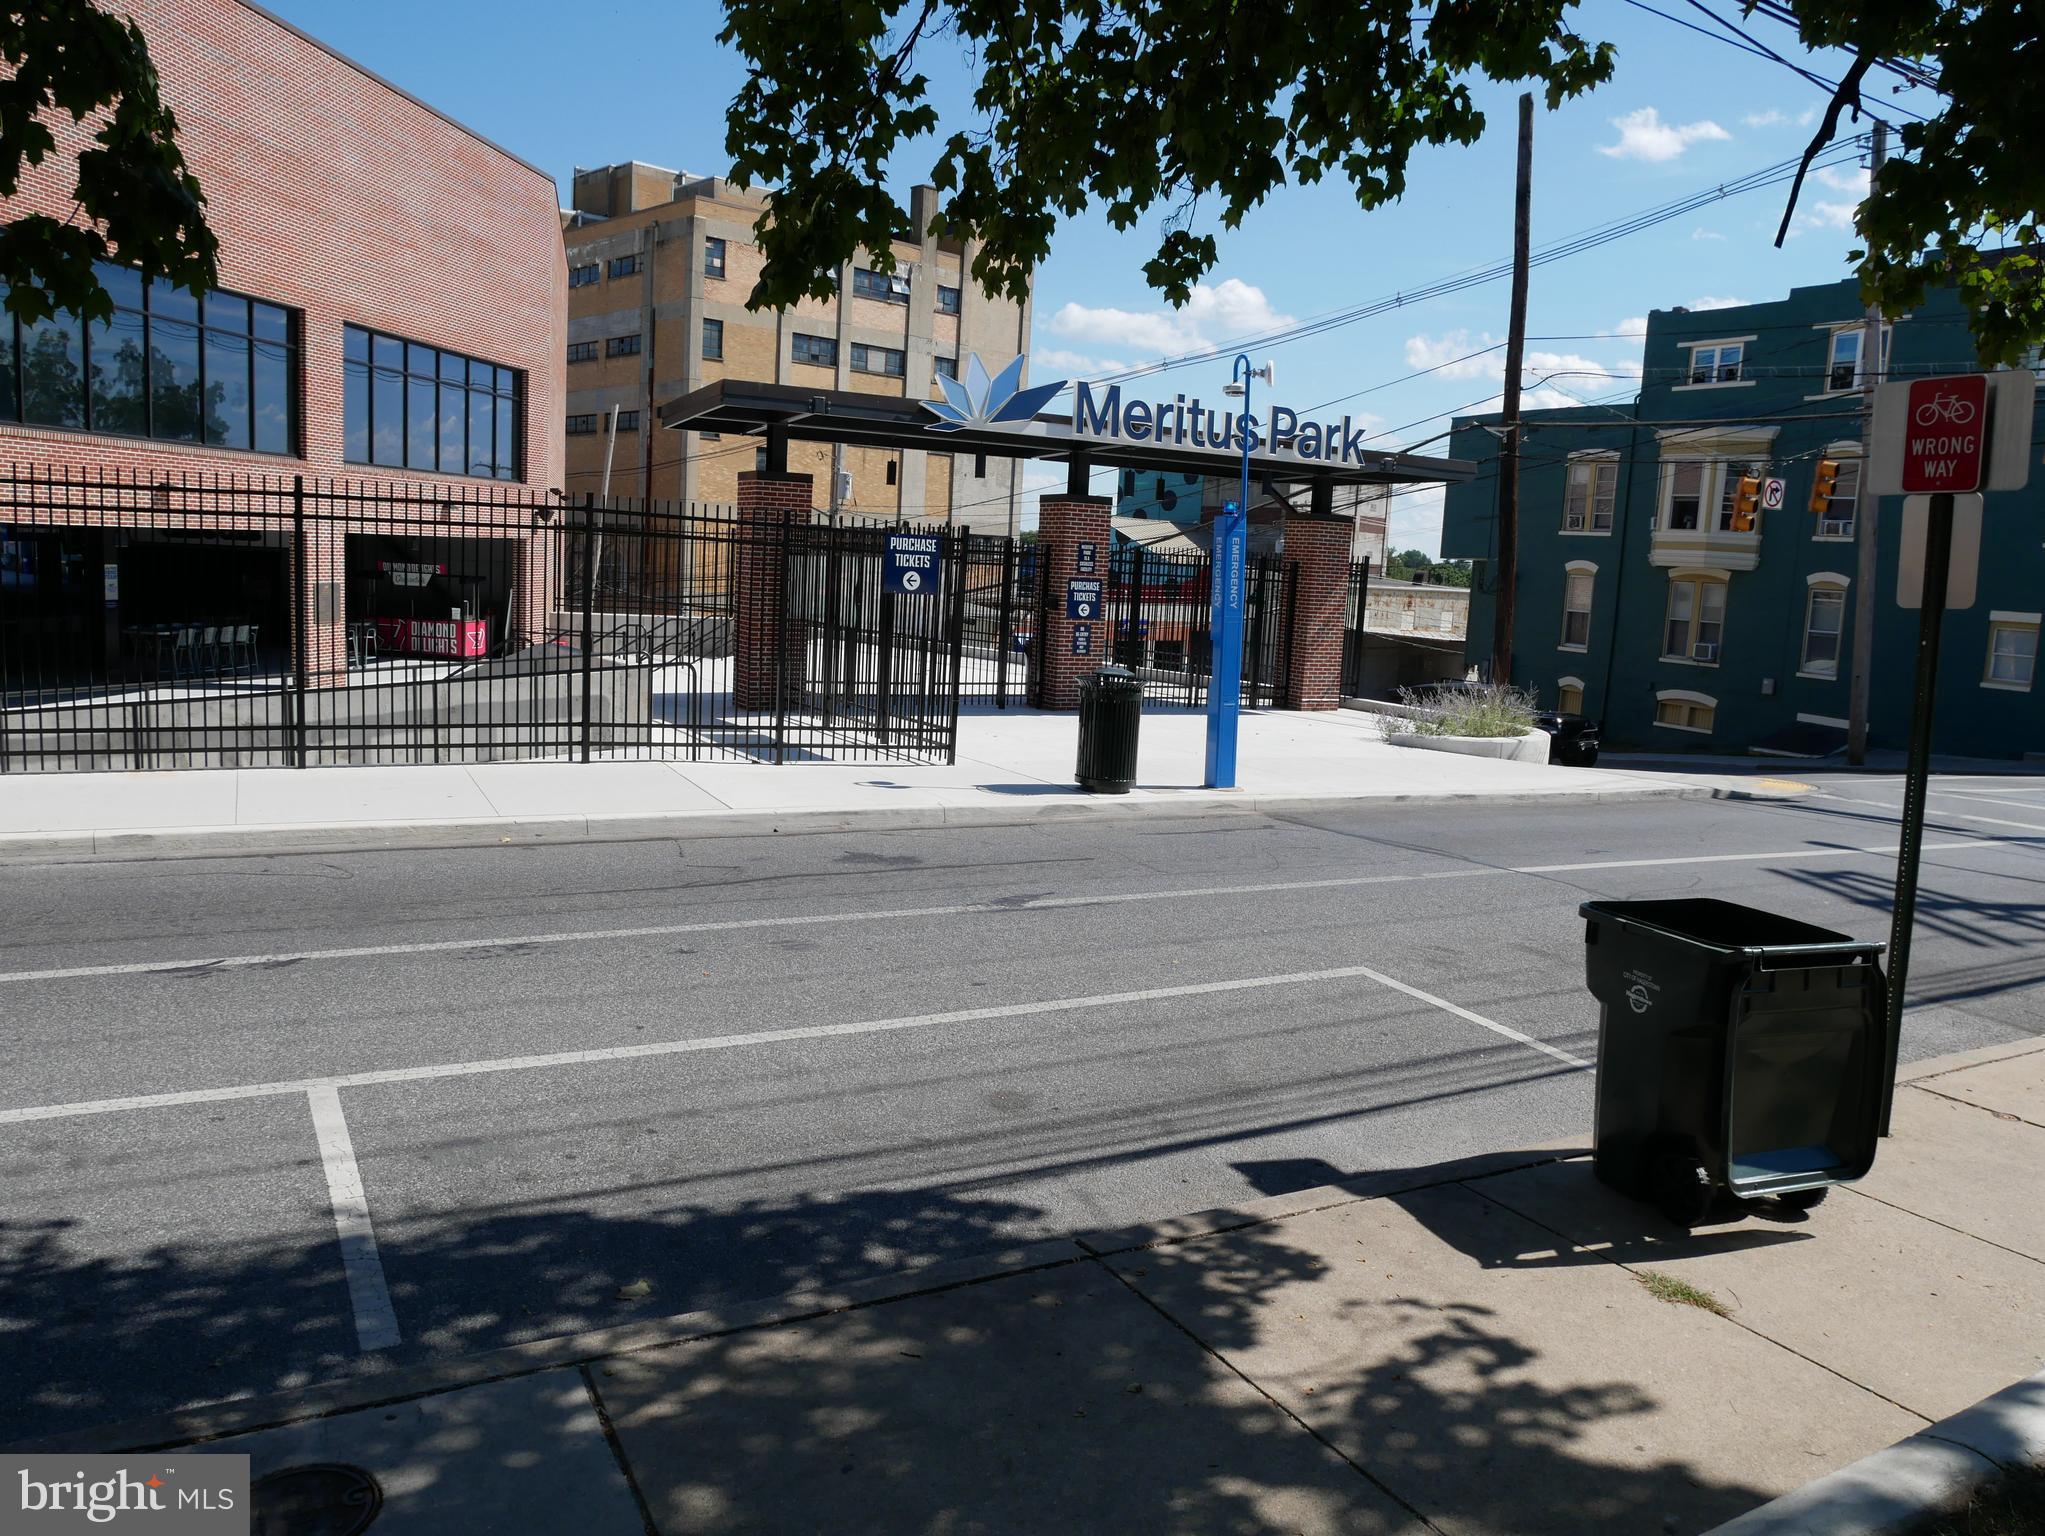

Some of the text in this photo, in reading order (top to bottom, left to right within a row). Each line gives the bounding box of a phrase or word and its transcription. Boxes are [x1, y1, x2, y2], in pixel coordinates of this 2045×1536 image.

[1074, 381, 1367, 466] Meritus Park
[1911, 436, 1975, 456] WRONG
[1924, 459, 1958, 478] WAY
[890, 536, 937, 552] PURCHASE
[895, 553, 931, 568] TICKETS
[1214, 536, 1223, 608] EMERGENCY
[1230, 537, 1241, 609] EMERGENCY
[1070, 581, 1100, 591] PURCHASE
[1073, 592, 1096, 602] TICKETS
[411, 621, 456, 638] DIAMOND
